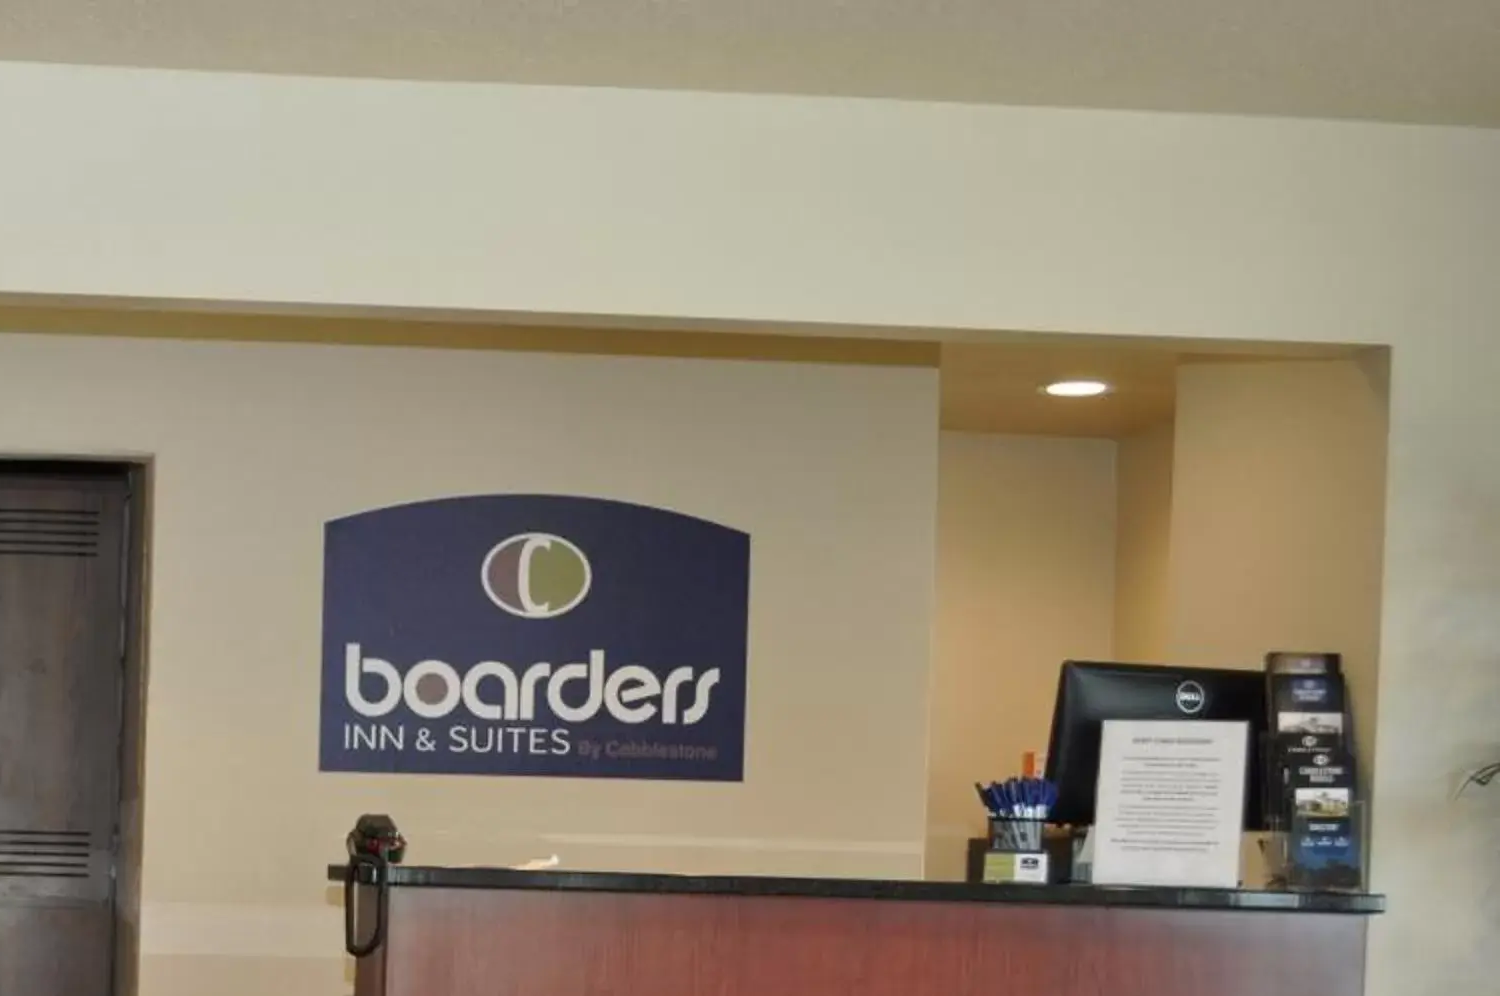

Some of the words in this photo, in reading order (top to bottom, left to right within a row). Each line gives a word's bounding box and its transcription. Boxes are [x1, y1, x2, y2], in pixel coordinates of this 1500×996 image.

[345, 642, 719, 725] boarders
[344, 723, 404, 751] INN
[415, 729, 436, 752] &
[449, 726, 570, 755] SUITES
